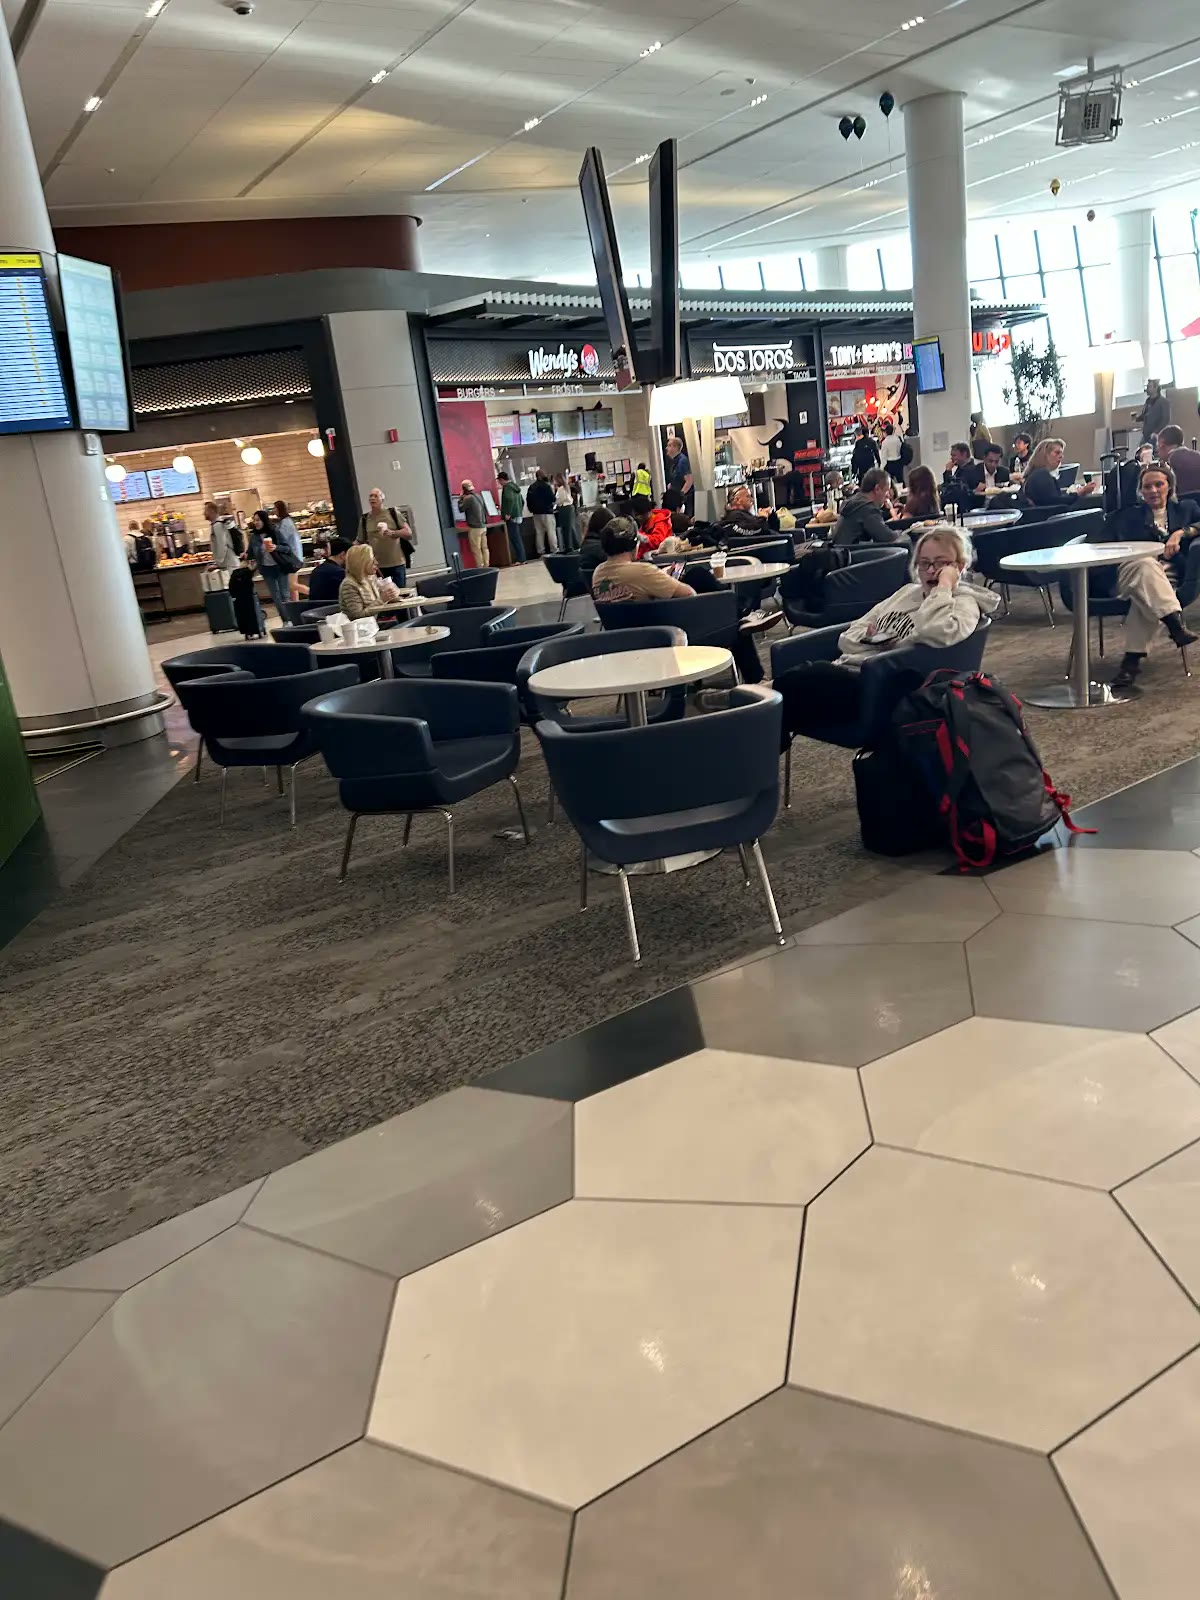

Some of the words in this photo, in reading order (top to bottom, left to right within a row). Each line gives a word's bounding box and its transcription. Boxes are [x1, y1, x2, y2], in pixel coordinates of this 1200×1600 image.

[528, 343, 579, 378] Wendy's
[713, 350, 746, 373] DOS
[747, 341, 794, 372] TOROS
[456, 386, 496, 399] BURGERS
